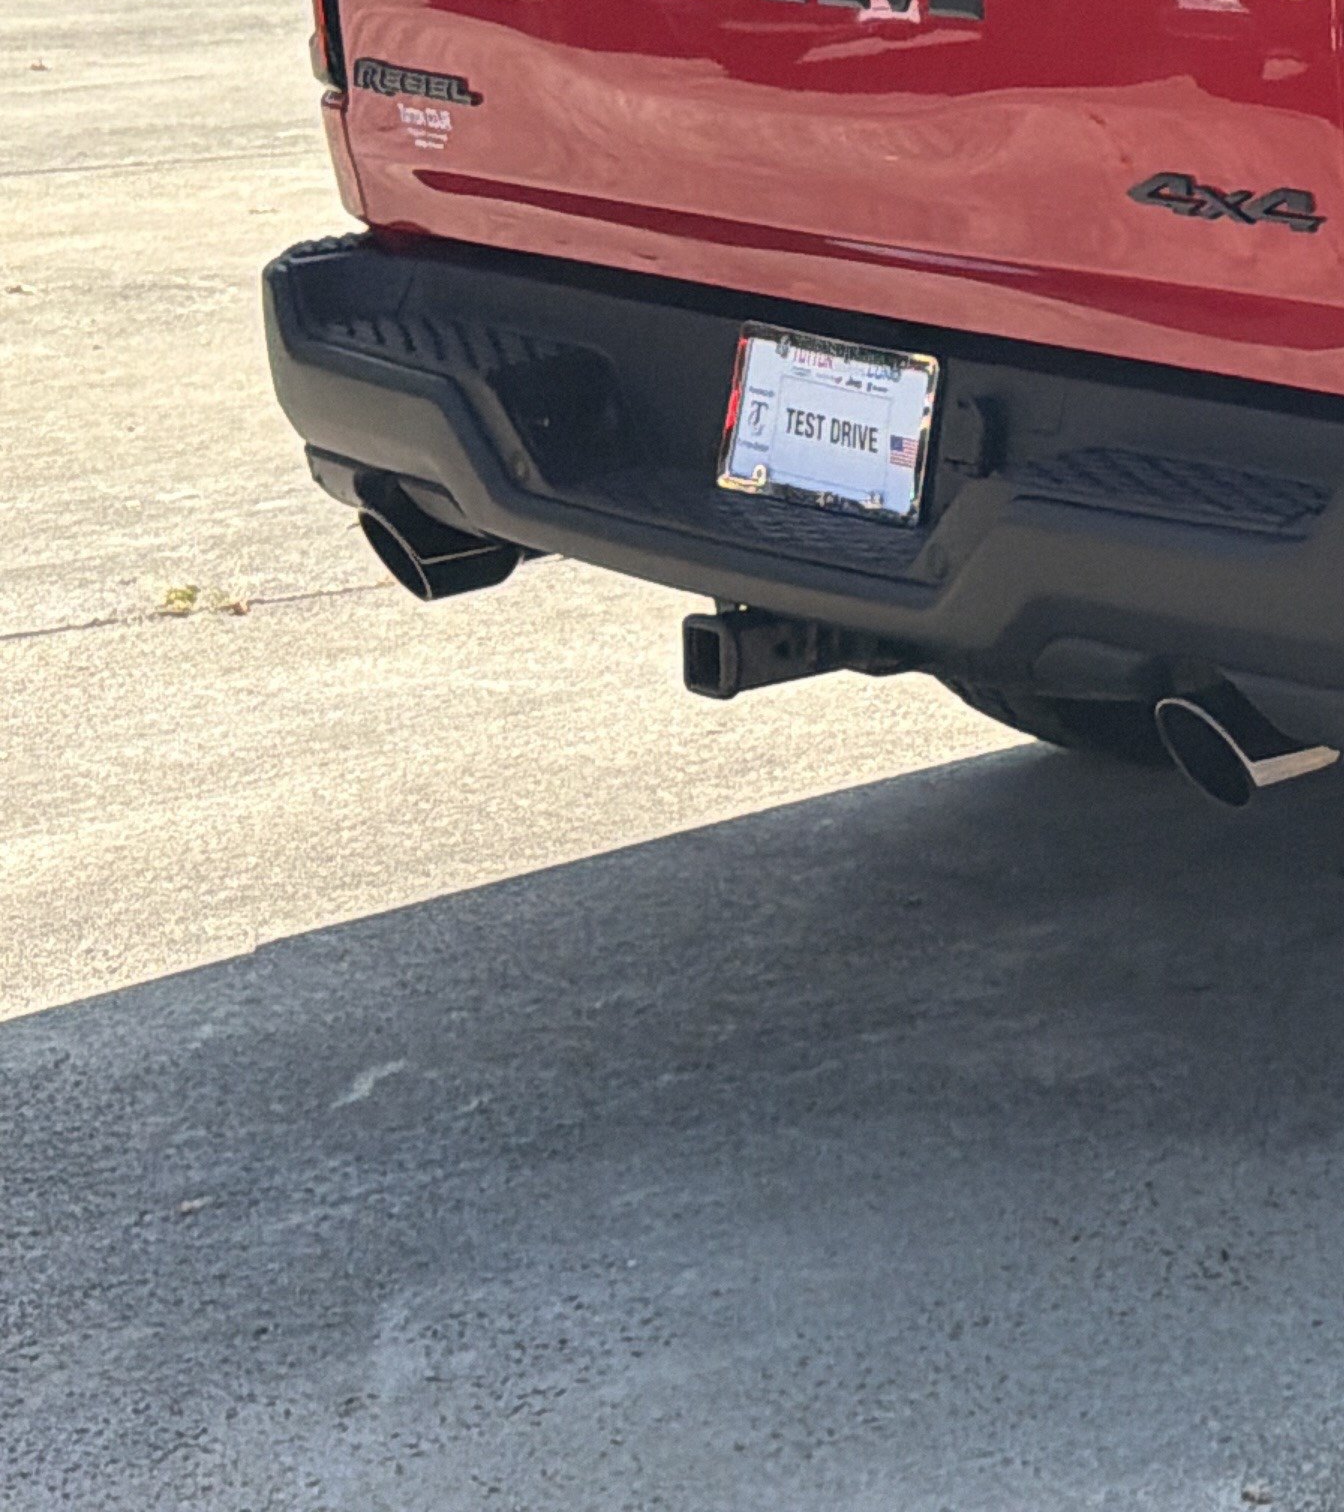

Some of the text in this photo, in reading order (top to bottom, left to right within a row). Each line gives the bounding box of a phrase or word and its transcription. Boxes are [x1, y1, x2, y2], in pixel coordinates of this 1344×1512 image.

[354, 57, 482, 107] REBEL
[785, 407, 879, 454] TEST DRIVE
